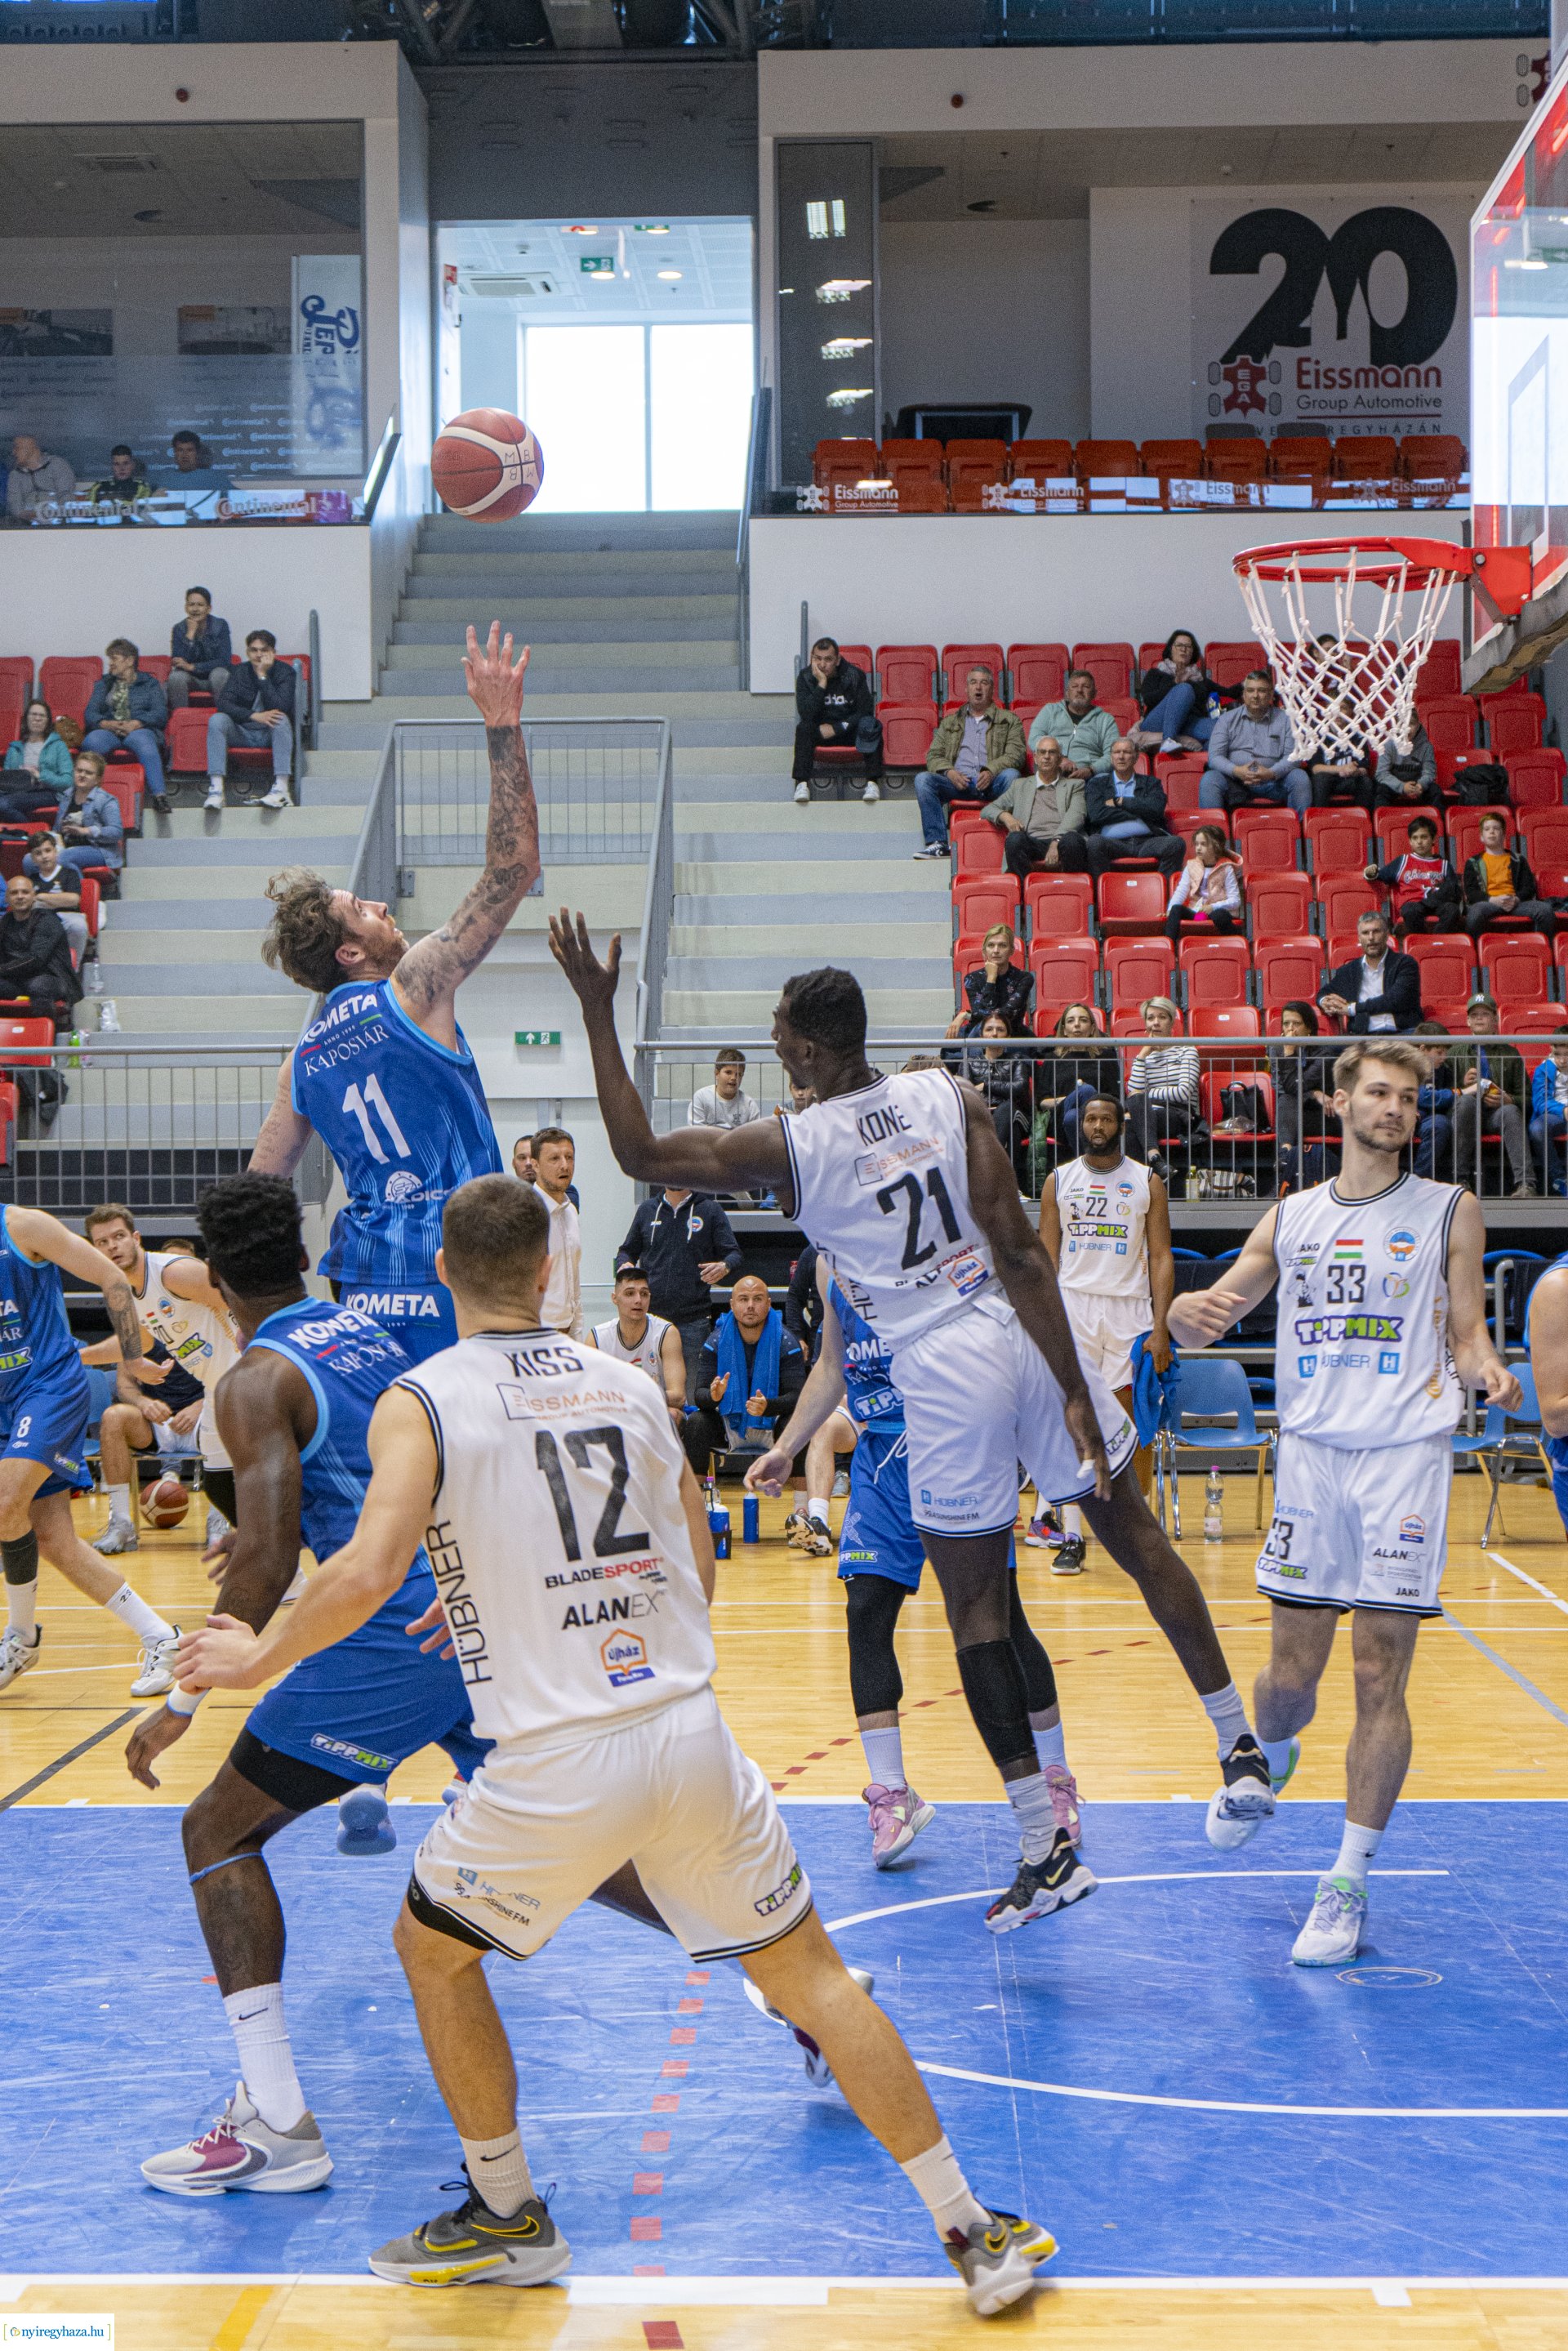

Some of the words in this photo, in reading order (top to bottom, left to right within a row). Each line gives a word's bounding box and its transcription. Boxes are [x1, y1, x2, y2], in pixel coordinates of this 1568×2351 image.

[1209, 206, 1458, 365] 20
[1297, 357, 1442, 390] Eissmann
[1236, 369, 1251, 404] EGA
[1297, 395, 1343, 413] Group
[1356, 395, 1442, 409] Automotive
[1327, 423, 1441, 435] REGYHÁZÁN
[835, 484, 898, 499] Eissmann
[1020, 483, 1085, 497] Eissmann
[1206, 480, 1270, 494] Eissmann
[1391, 477, 1456, 493] Eissmann
[215, 497, 317, 519] Continental
[835, 500, 858, 509] Group
[301, 994, 377, 1046] KOMETA
[304, 1024, 390, 1077] KAPOSVÁR
[323, 1033, 341, 1046] ANNO
[342, 1073, 412, 1164] 11
[1085, 1197, 1107, 1217] 22
[876, 1167, 962, 1270] 21
[1298, 1243, 1320, 1251] AKO
[1327, 1265, 1367, 1304] 33
[345, 1293, 440, 1317] KOMETA
[846, 1339, 892, 1362] OME
[16, 1416, 32, 1438] 8
[536, 1425, 650, 1562] 12
[839, 1550, 878, 1564] PPMIX
[1373, 1548, 1422, 1563] ALANEX
[545, 1557, 660, 1589] BLADESPORT
[425, 1520, 492, 1685] HÜBNER
[1396, 1587, 1419, 1597] JAKO
[562, 1591, 661, 1630] ALANEX
